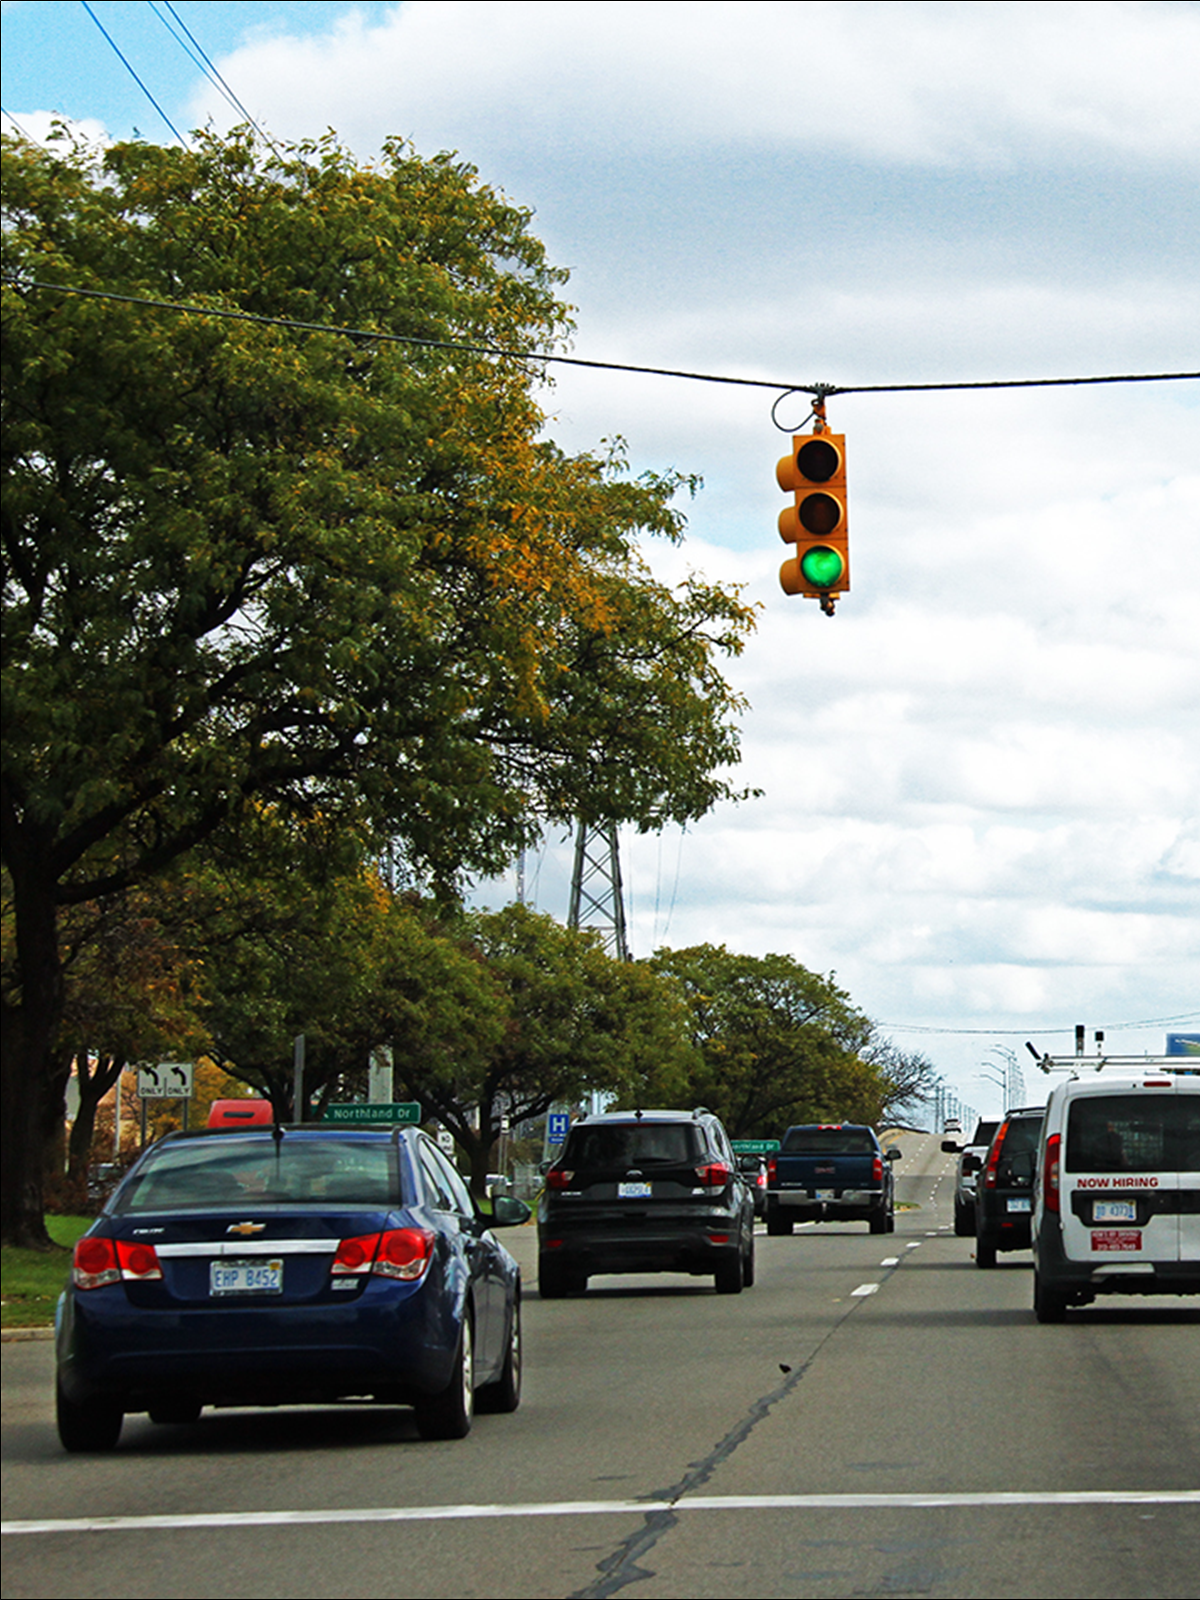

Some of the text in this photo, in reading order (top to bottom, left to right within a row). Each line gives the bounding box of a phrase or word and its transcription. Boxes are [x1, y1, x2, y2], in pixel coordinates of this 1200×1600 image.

[140, 1086, 163, 1096] ONLY
[167, 1086, 190, 1096] ONLY
[334, 1107, 411, 1120] Northland Dr
[553, 1117, 565, 1132] H
[1077, 1177, 1159, 1188] NOW HIRING
[214, 1268, 278, 1288] EHP 8452
